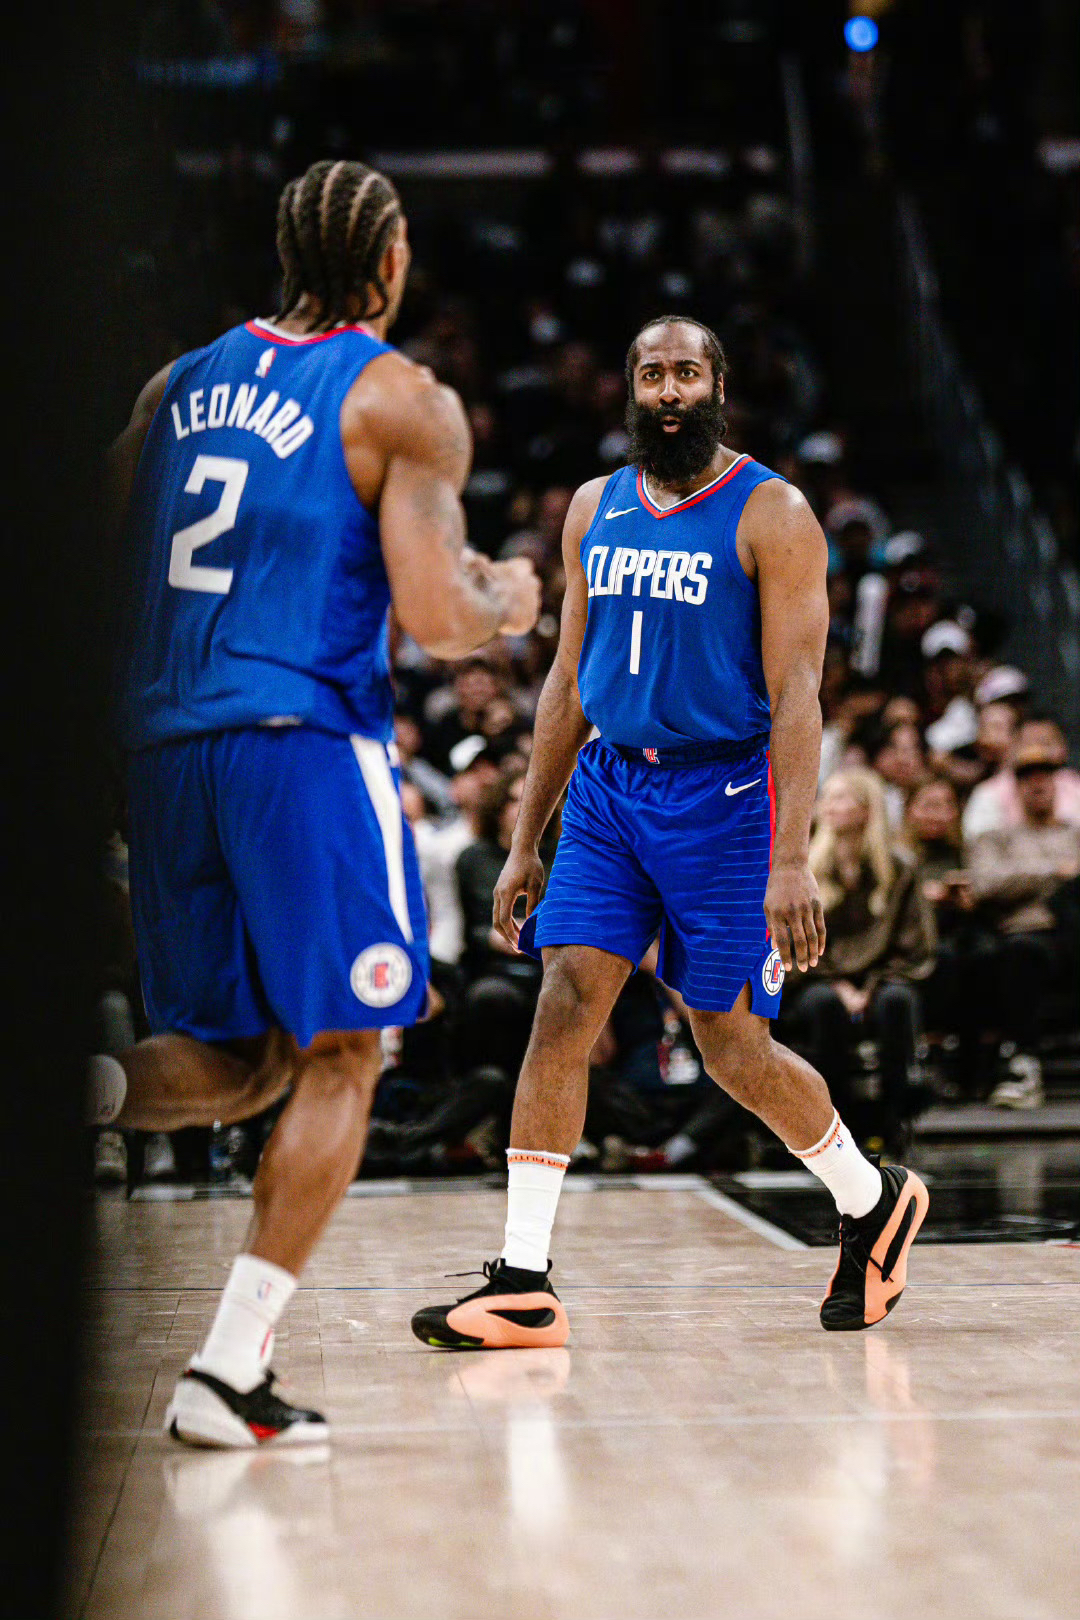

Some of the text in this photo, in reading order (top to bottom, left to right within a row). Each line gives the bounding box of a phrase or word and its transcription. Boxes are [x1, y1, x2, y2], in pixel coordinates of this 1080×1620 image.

[171, 383, 314, 459] LEONARD
[168, 454, 249, 594] 2
[587, 545, 713, 606] CLIPPERS
[629, 610, 643, 675] 1
